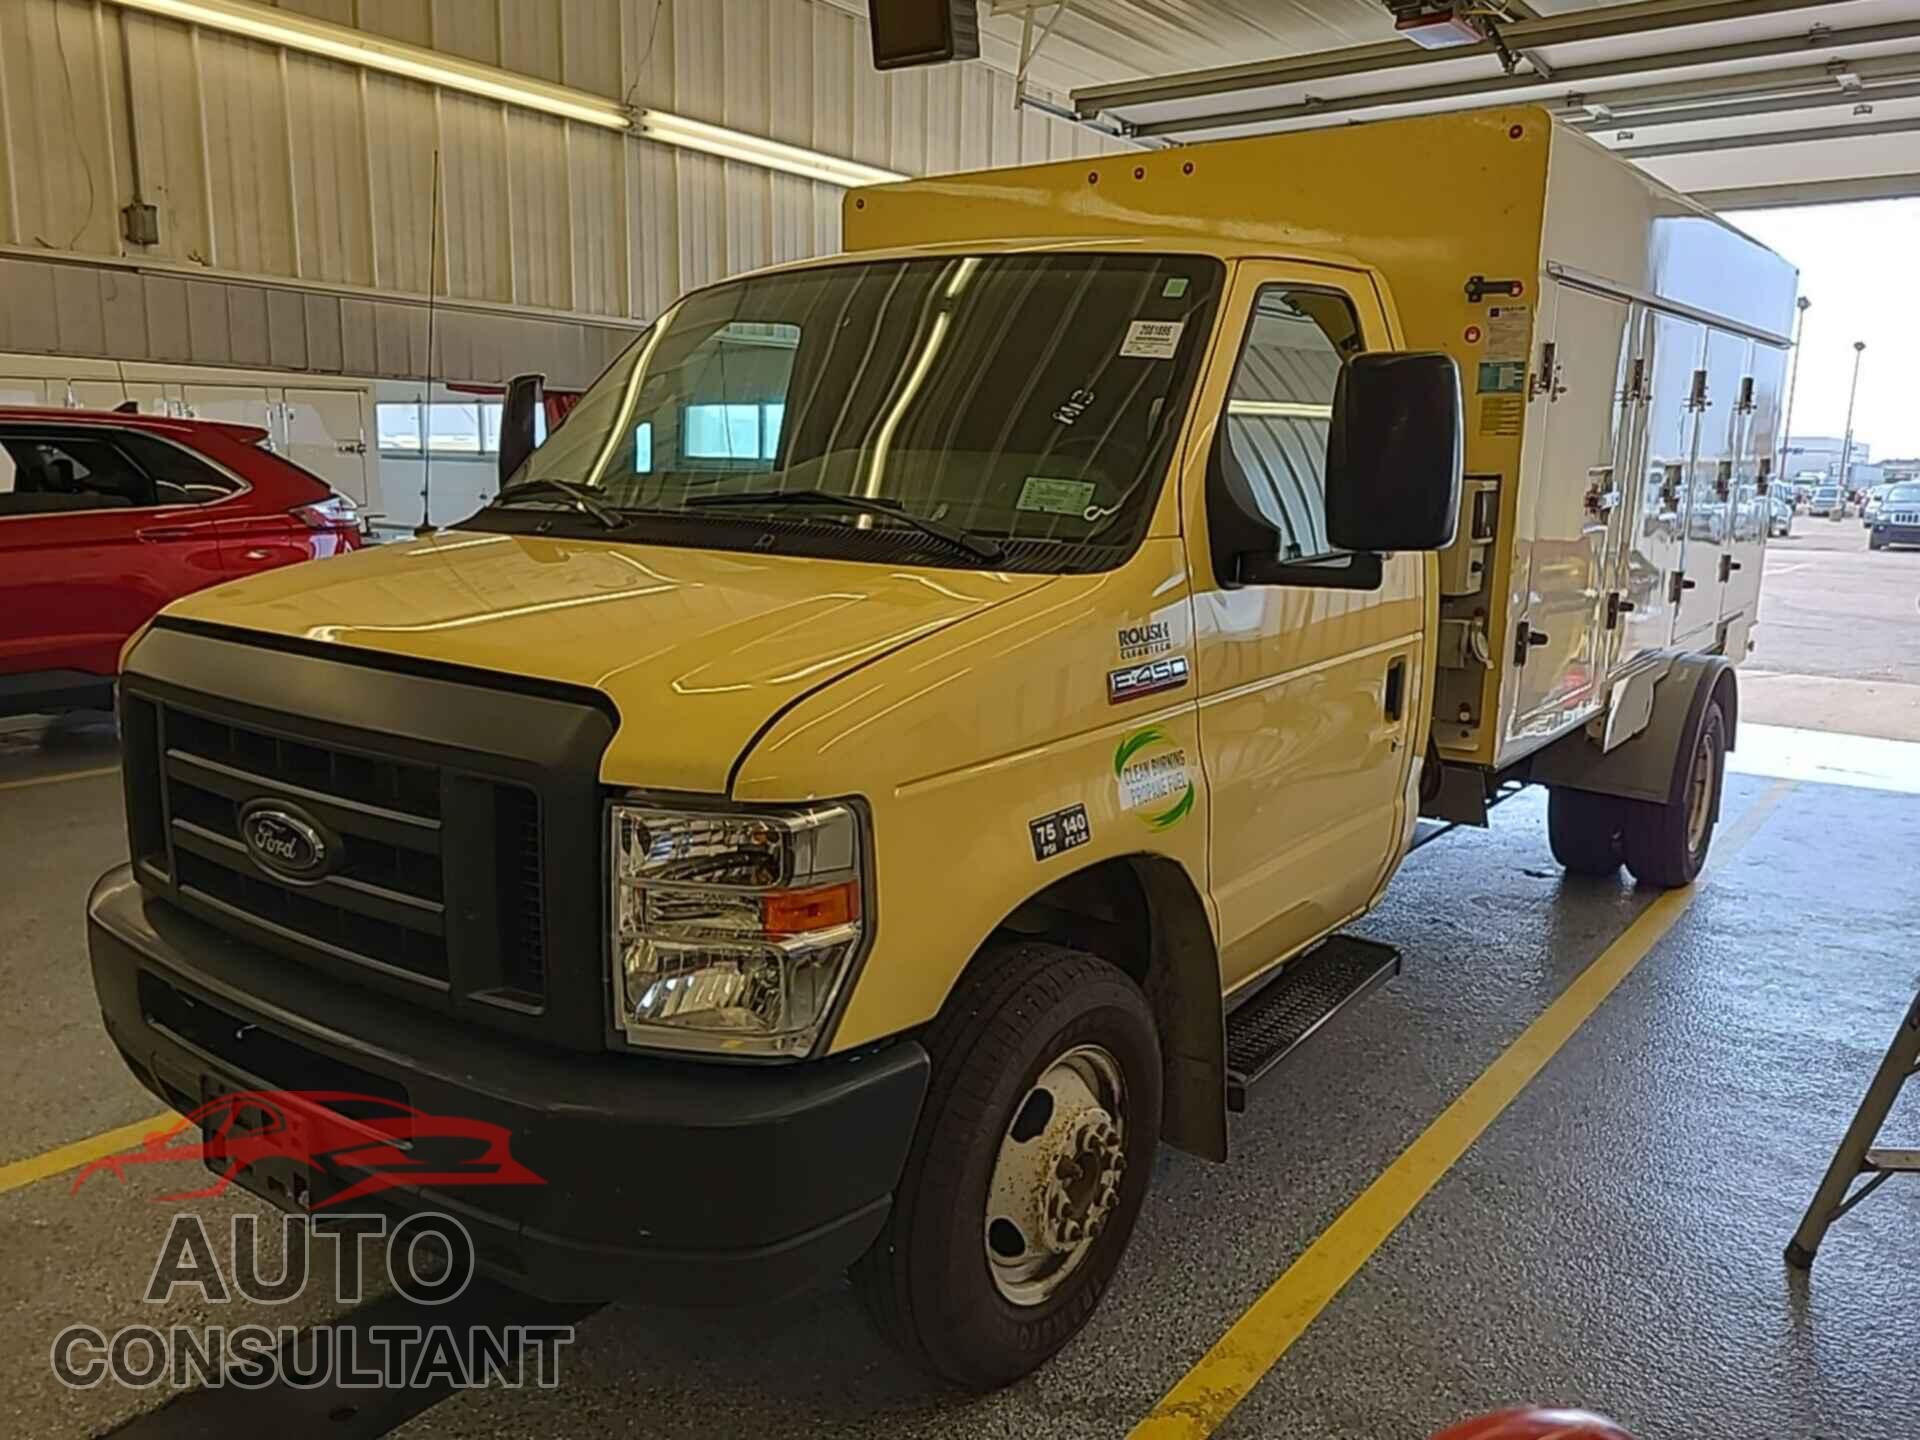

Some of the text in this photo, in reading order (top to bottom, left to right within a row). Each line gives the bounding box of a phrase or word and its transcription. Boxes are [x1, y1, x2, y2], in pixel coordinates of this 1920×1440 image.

[1117, 621, 1170, 648] ROUSH
[1123, 748, 1186, 786] CLEAN BURNING
[1035, 822, 1057, 845] 75
[1062, 813, 1086, 836] 140
[256, 819, 298, 859] Ford
